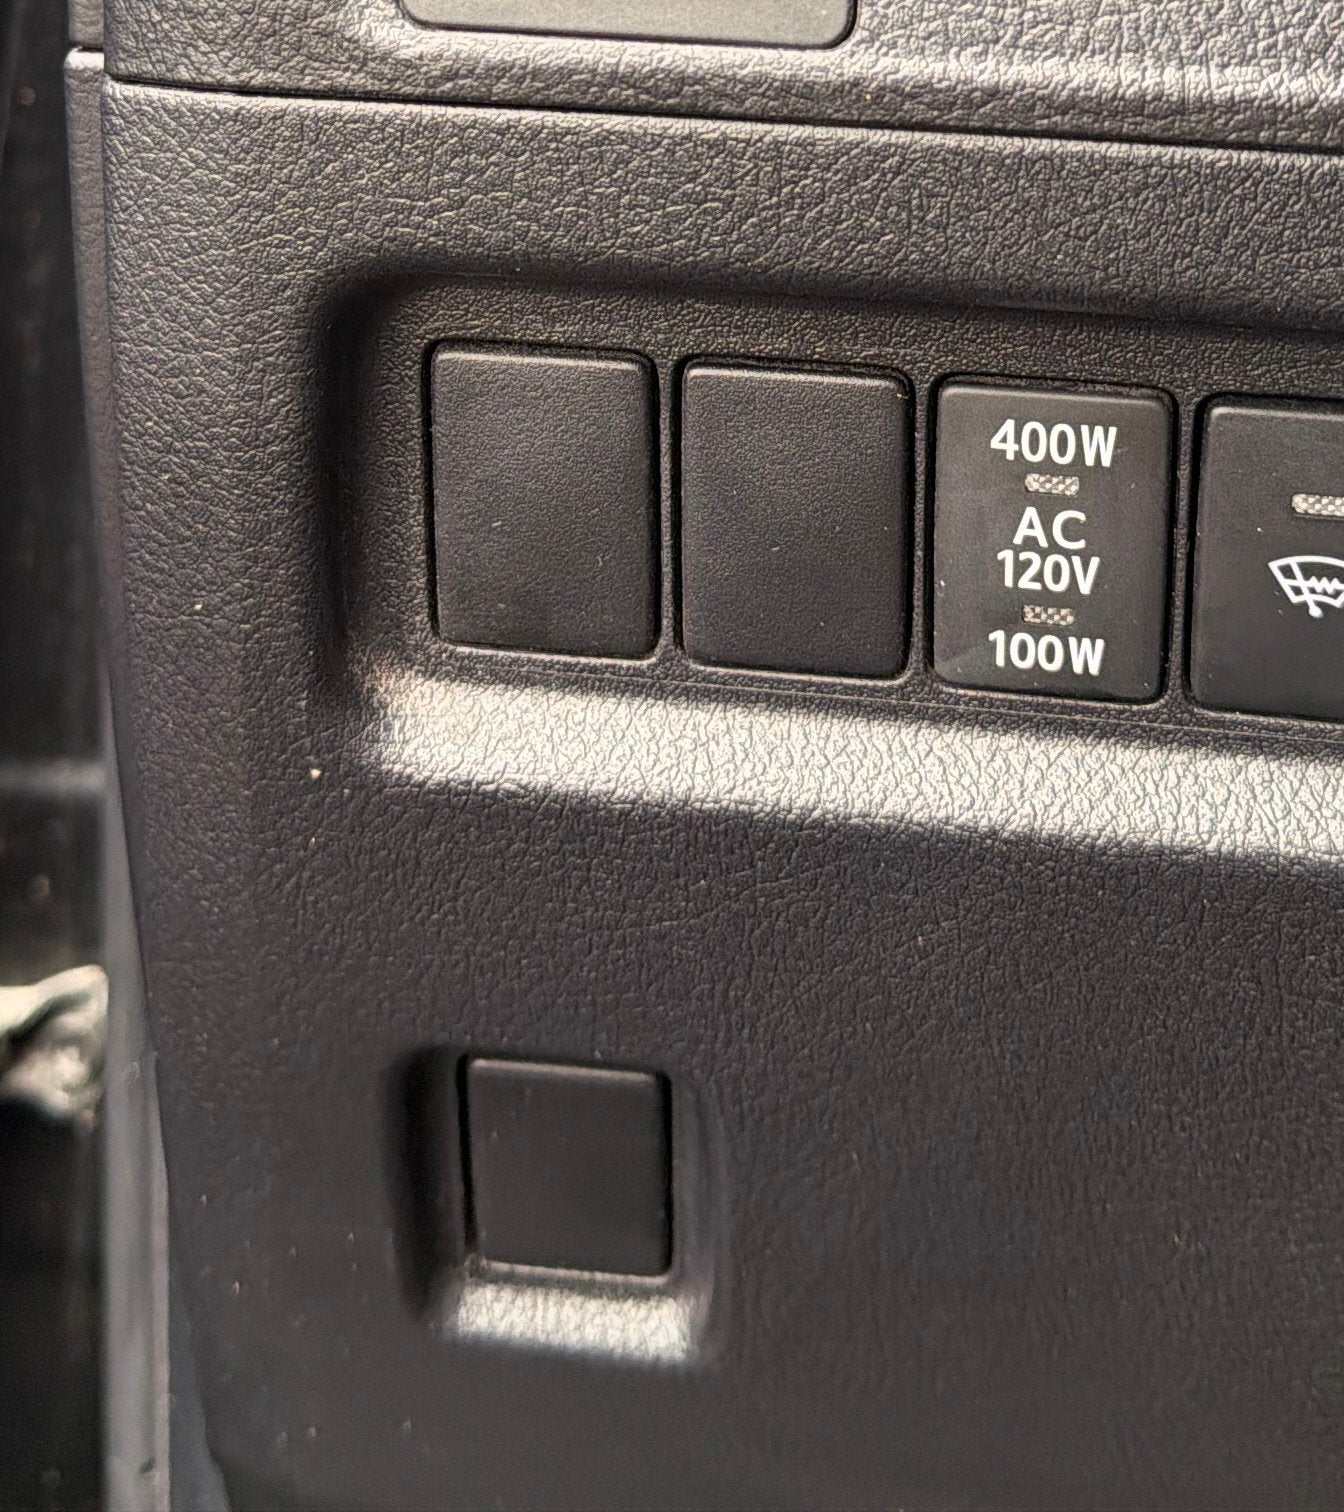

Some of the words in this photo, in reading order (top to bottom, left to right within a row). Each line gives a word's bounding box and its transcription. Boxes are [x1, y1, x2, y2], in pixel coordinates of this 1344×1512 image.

[989, 417, 1118, 468] 400W
[1012, 506, 1088, 550] AC
[996, 549, 1101, 596] 120V
[988, 628, 1105, 676] 100W
